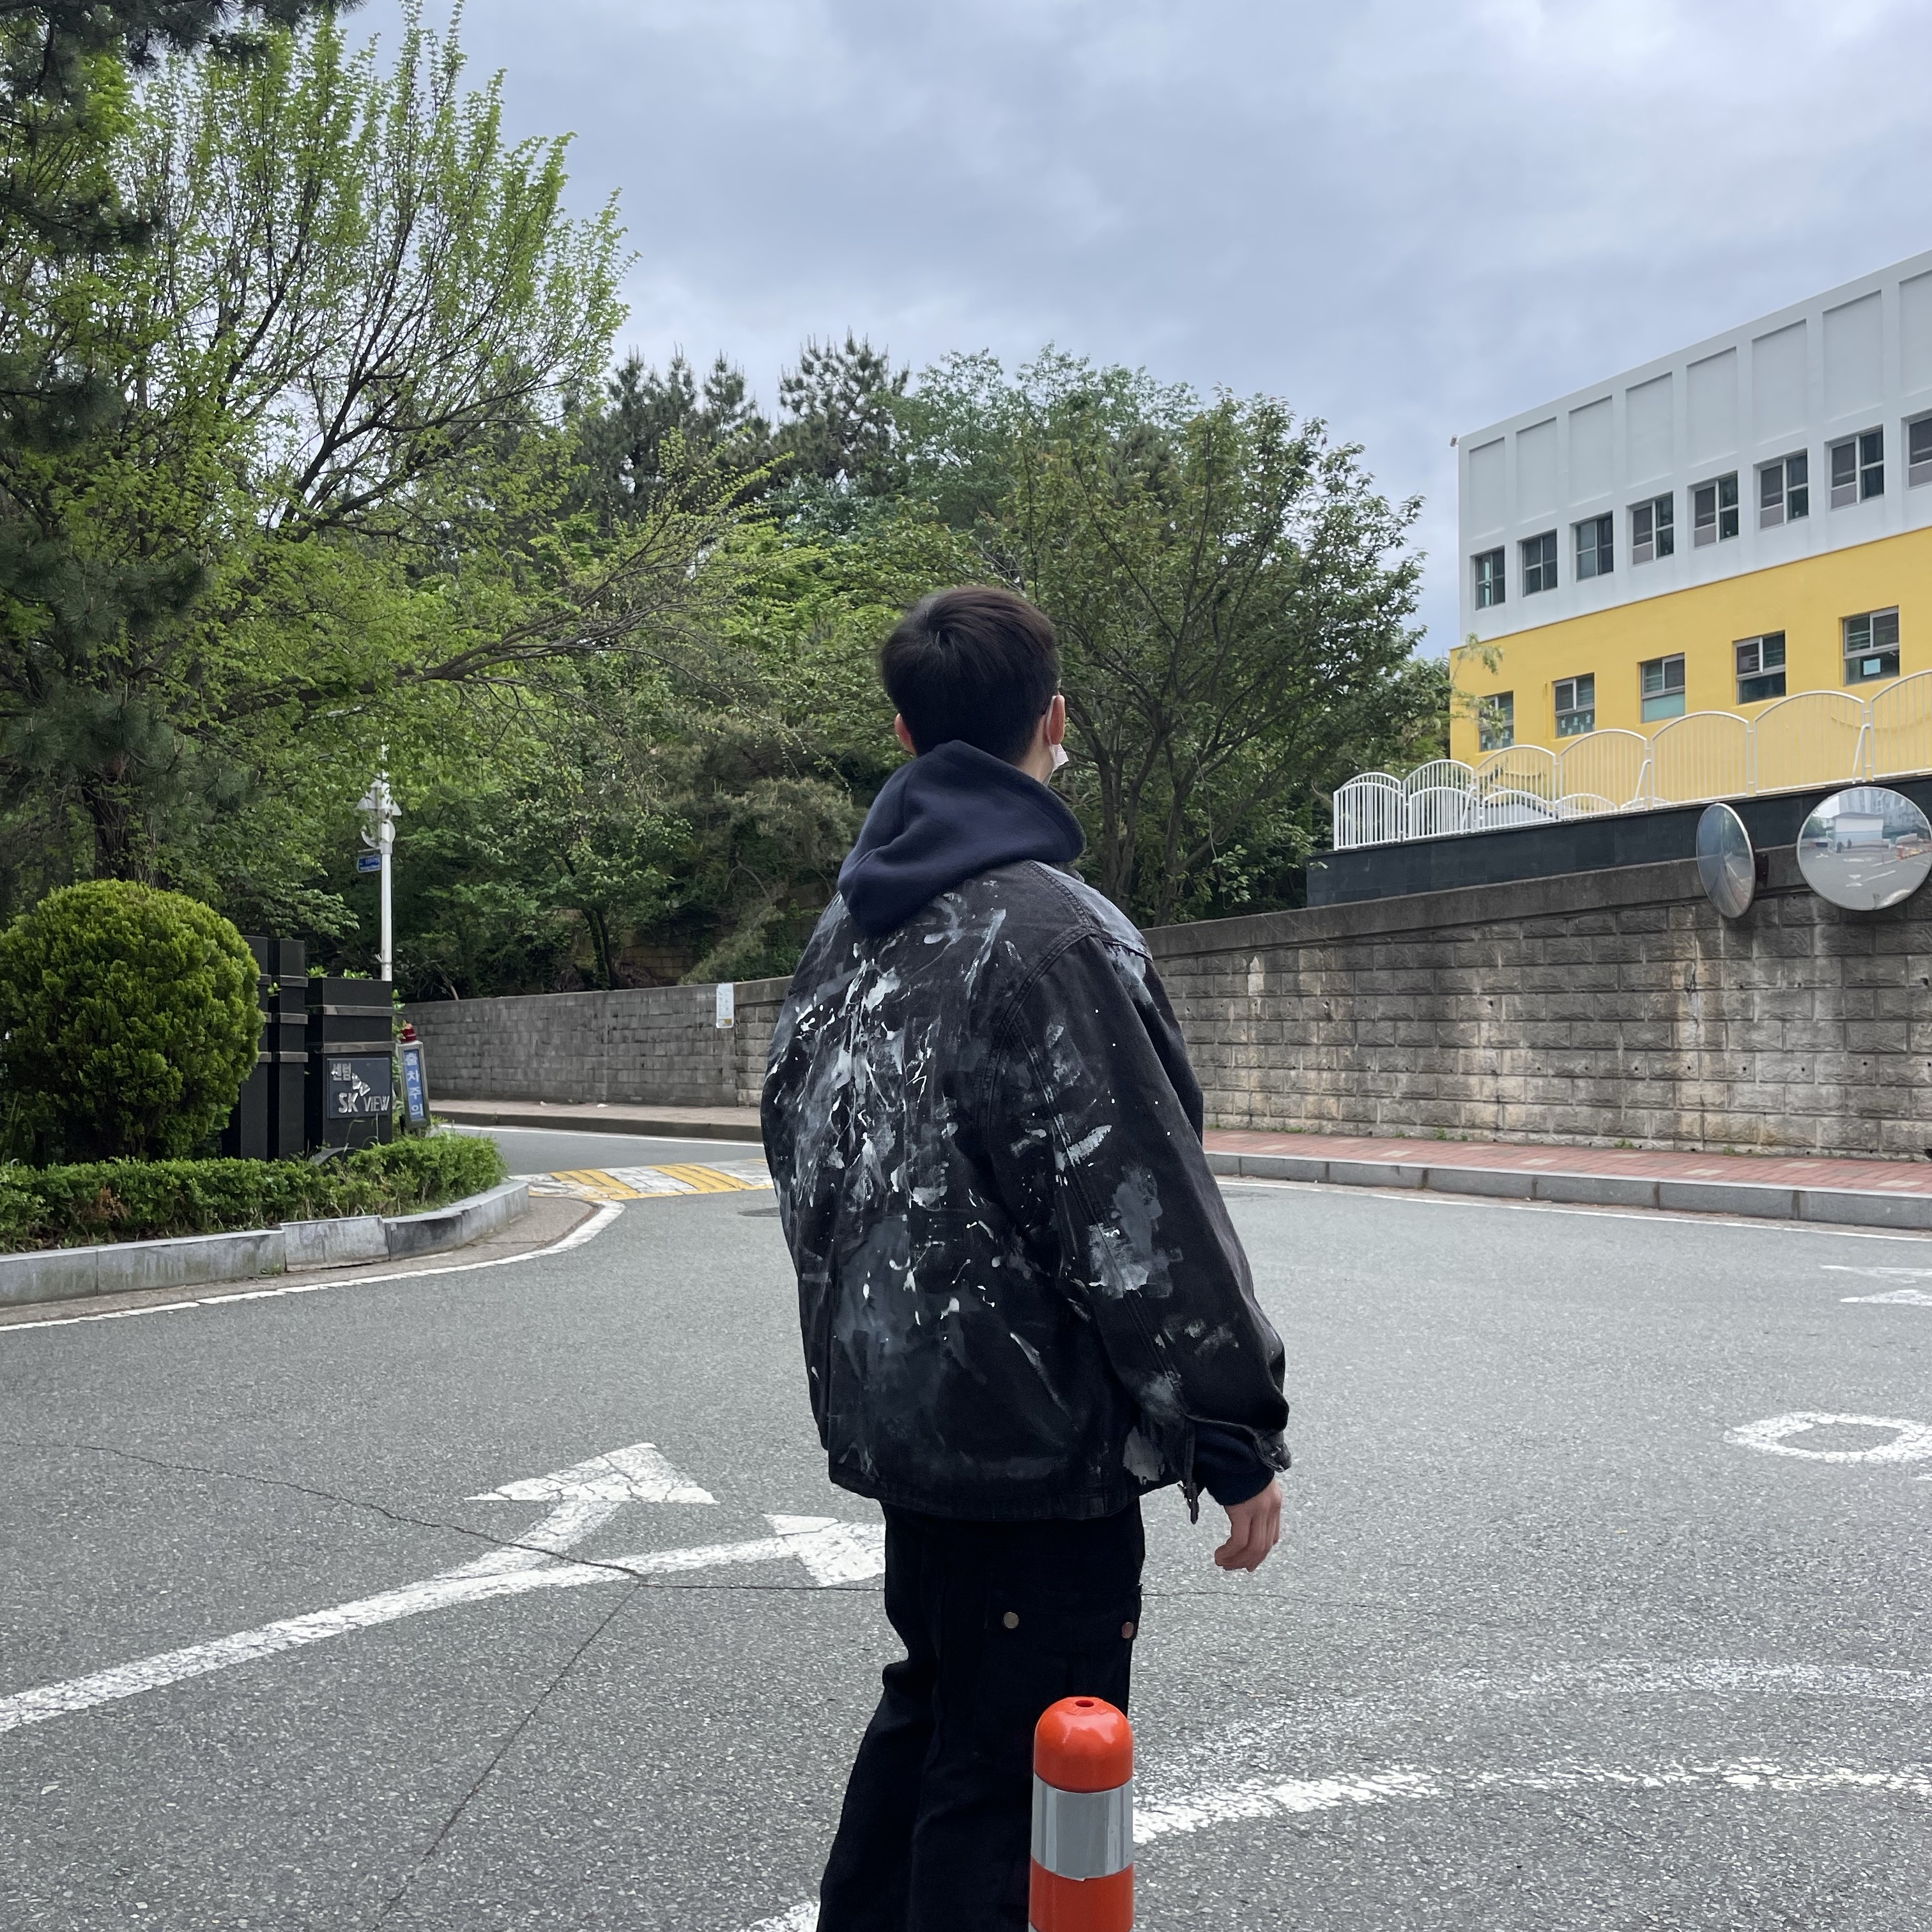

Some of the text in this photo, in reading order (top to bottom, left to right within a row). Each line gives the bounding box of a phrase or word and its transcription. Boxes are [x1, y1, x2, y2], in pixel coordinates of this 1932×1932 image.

[332, 1063, 351, 1081] 센텀
[339, 1092, 390, 1113] SK VIEW
